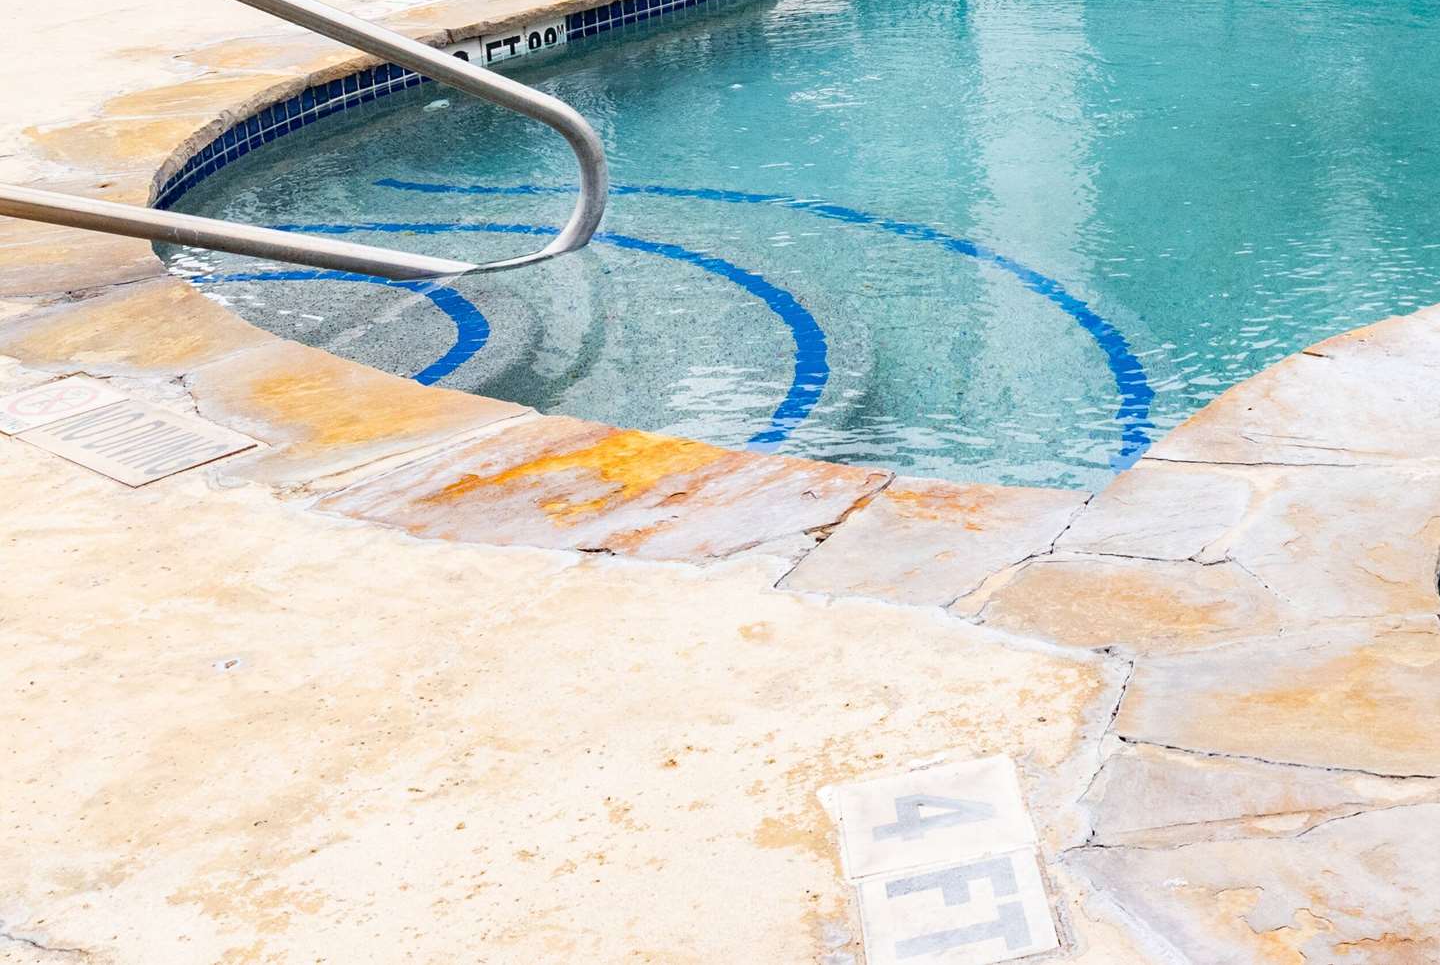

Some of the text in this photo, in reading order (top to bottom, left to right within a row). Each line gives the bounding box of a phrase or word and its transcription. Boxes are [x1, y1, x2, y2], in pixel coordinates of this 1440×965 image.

[42, 403, 145, 441] NO
[80, 418, 230, 475] DIVING
[872, 793, 1034, 960] 4 FT
